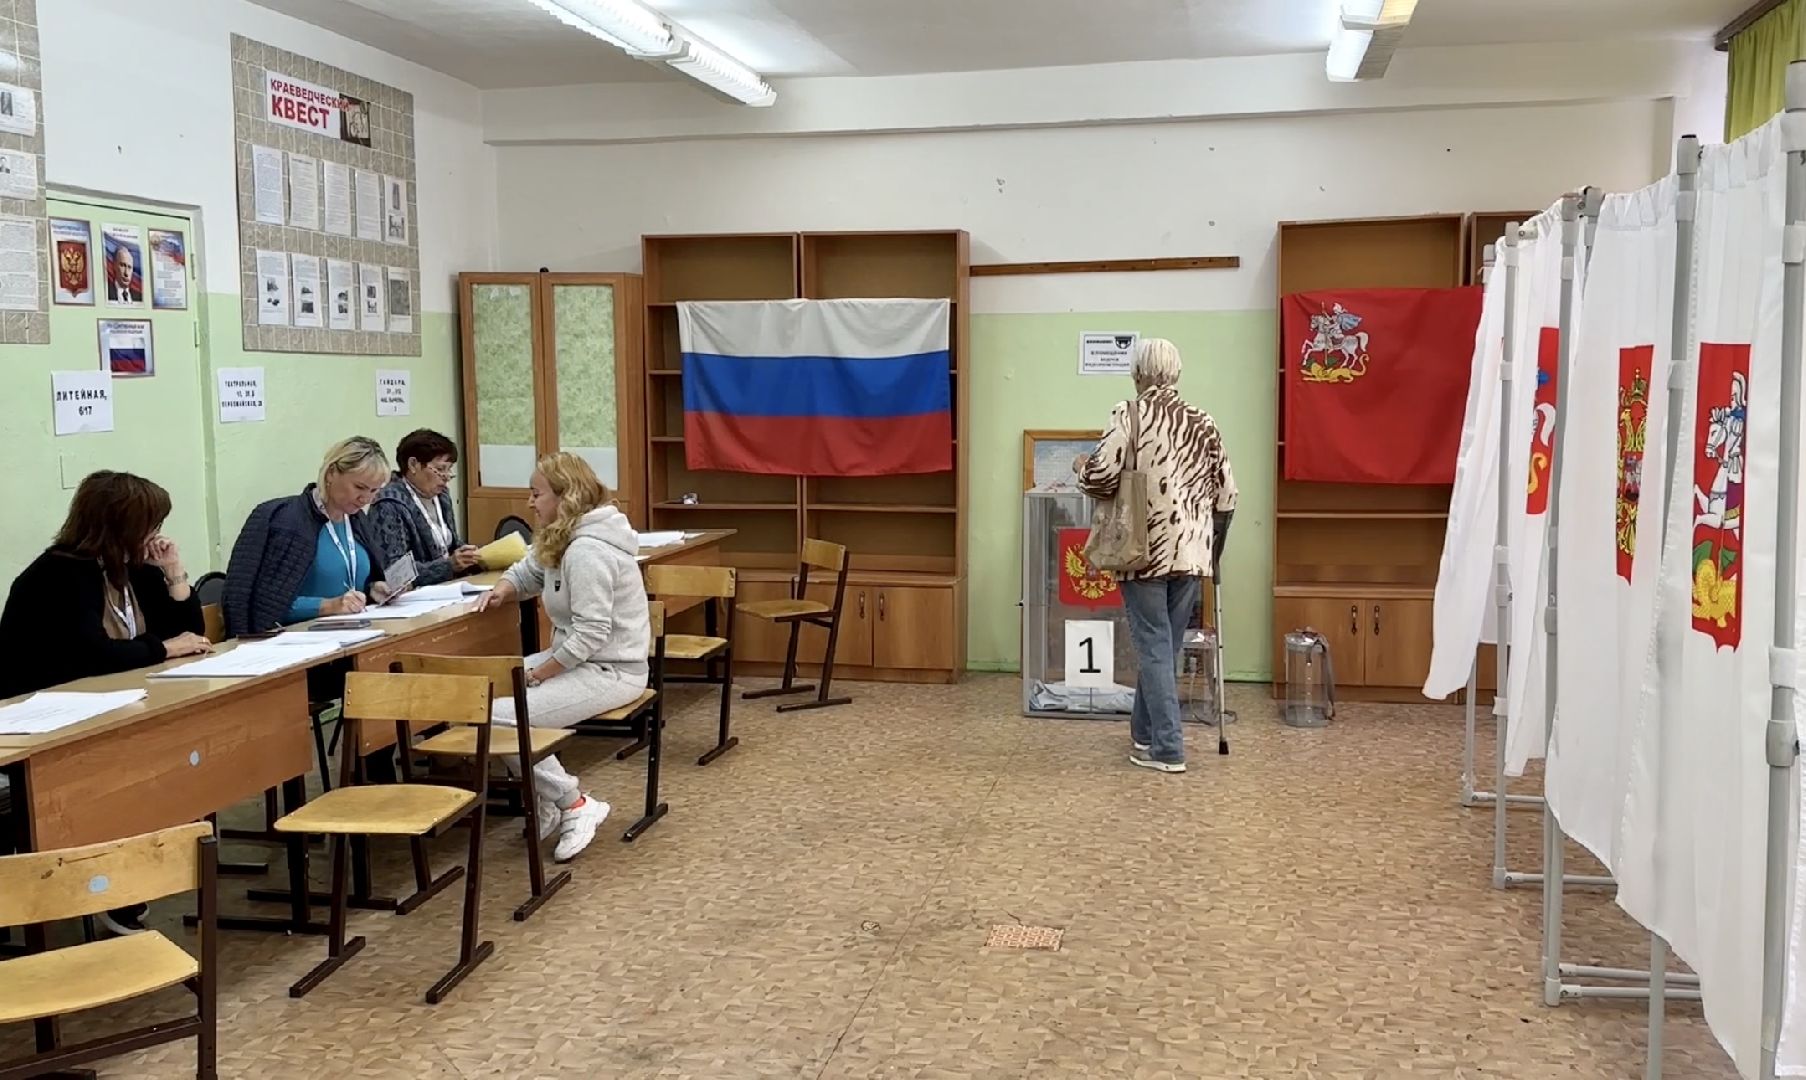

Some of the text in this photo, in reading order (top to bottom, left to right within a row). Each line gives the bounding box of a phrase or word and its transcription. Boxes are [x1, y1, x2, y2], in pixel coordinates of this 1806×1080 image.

[271, 94, 330, 129] КВЕСТ
[56, 388, 107, 402] ЛИТЕЙНАЯ,
[1079, 636, 1102, 674] 1
